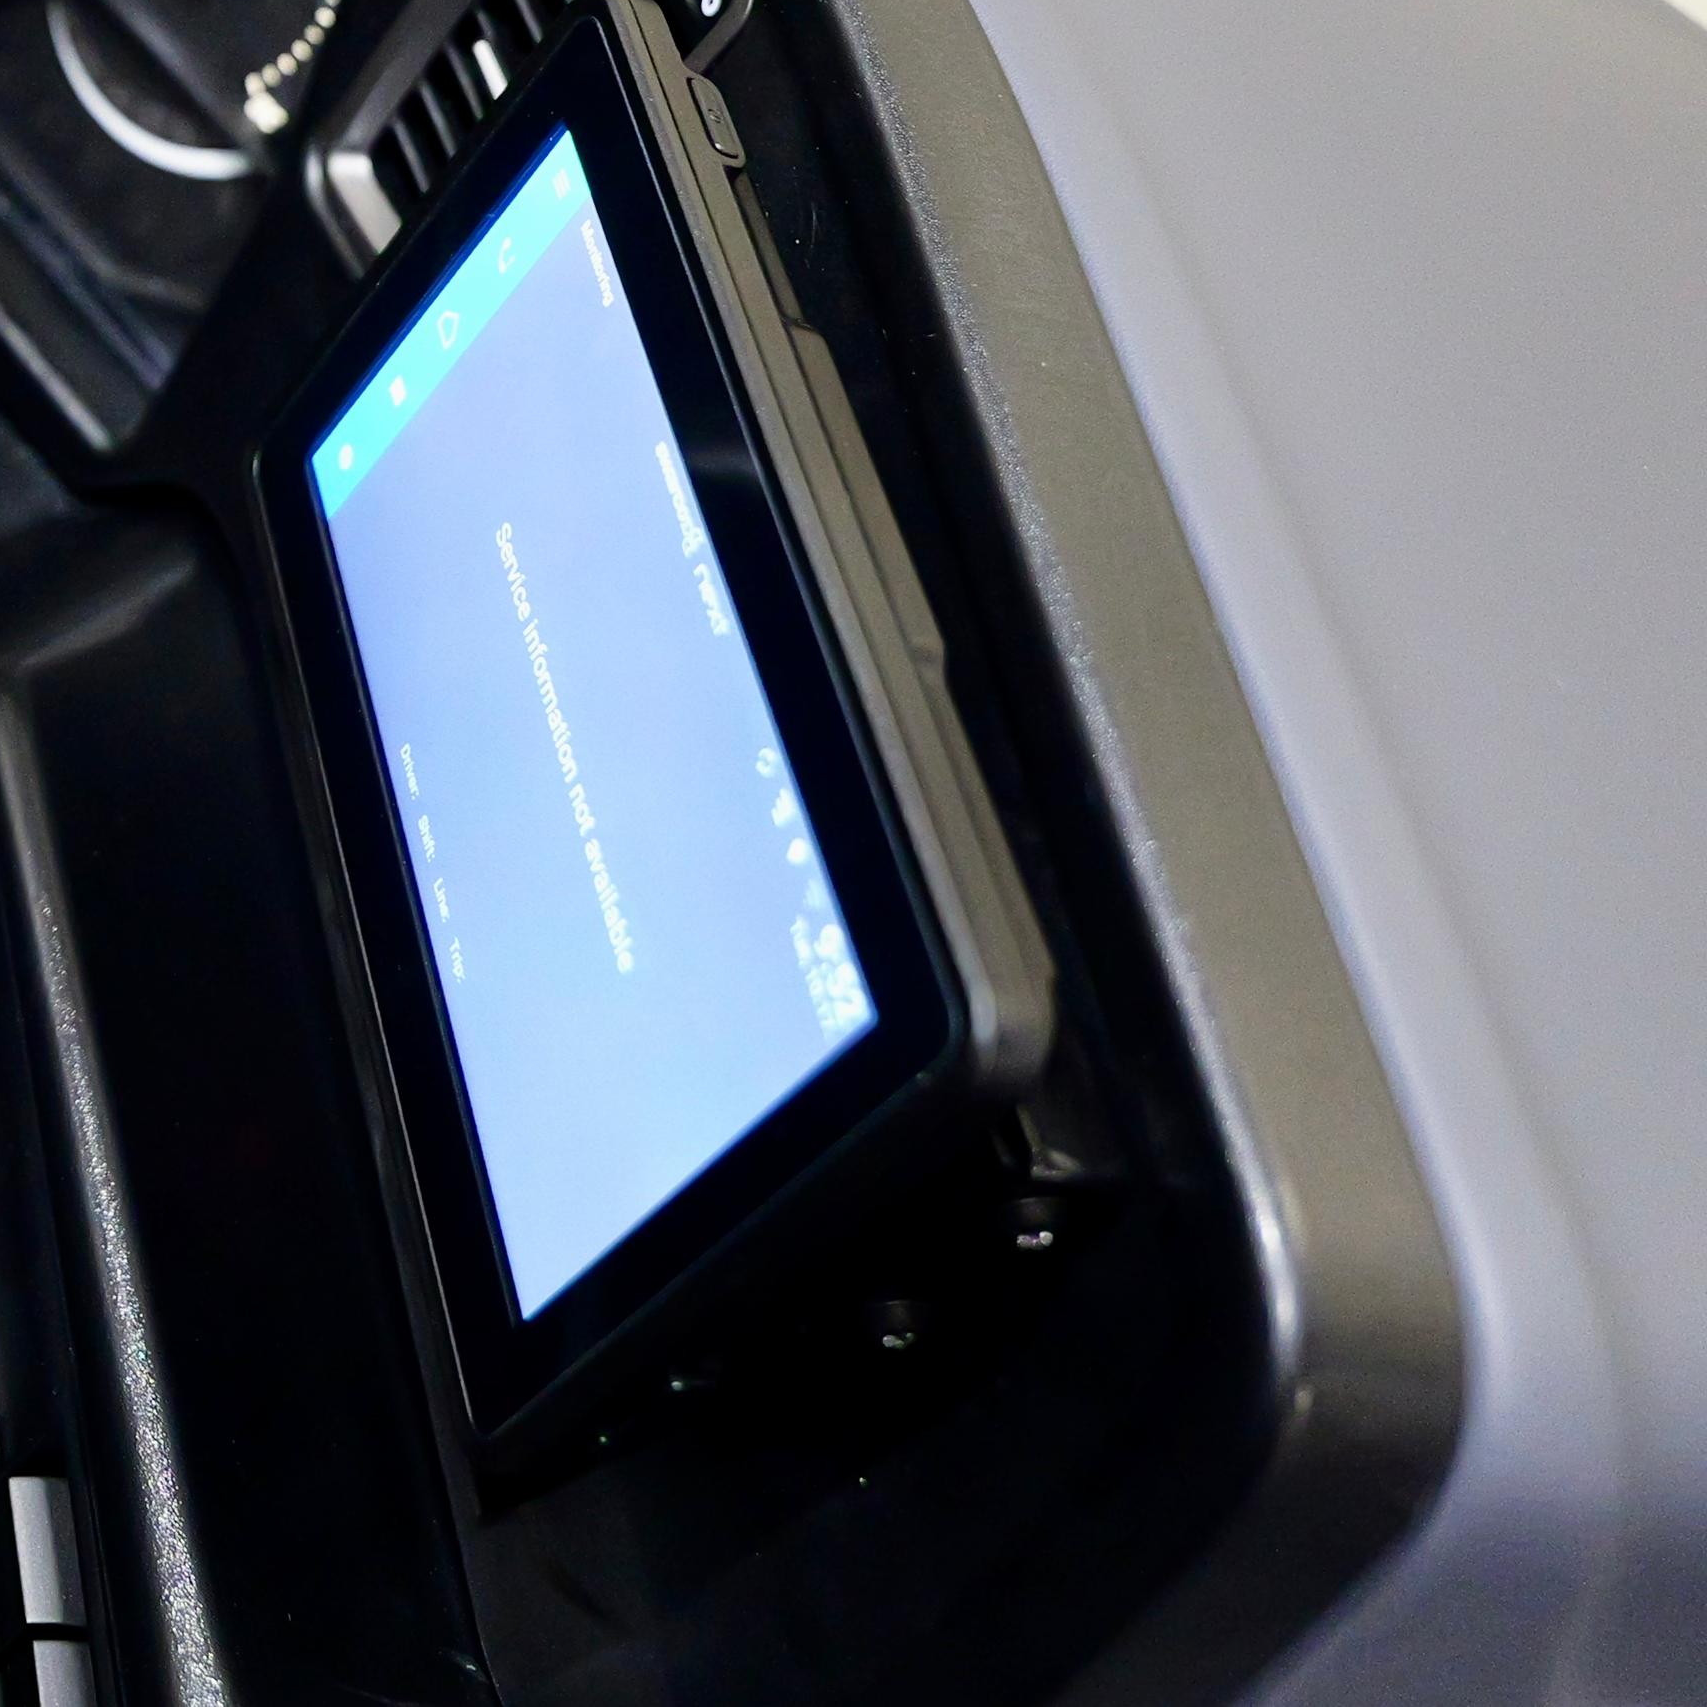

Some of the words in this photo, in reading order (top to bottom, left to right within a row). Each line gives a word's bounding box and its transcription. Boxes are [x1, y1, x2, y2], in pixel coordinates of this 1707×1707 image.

[580, 219, 614, 307] Monitoring
[400, 743, 419, 800] Driver:
[418, 814, 435, 864] Shift:
[449, 935, 465, 984] Trip:
[495, 522, 531, 622] Service
[523, 617, 577, 783] information
[569, 783, 596, 836] not
[585, 838, 634, 975] available
